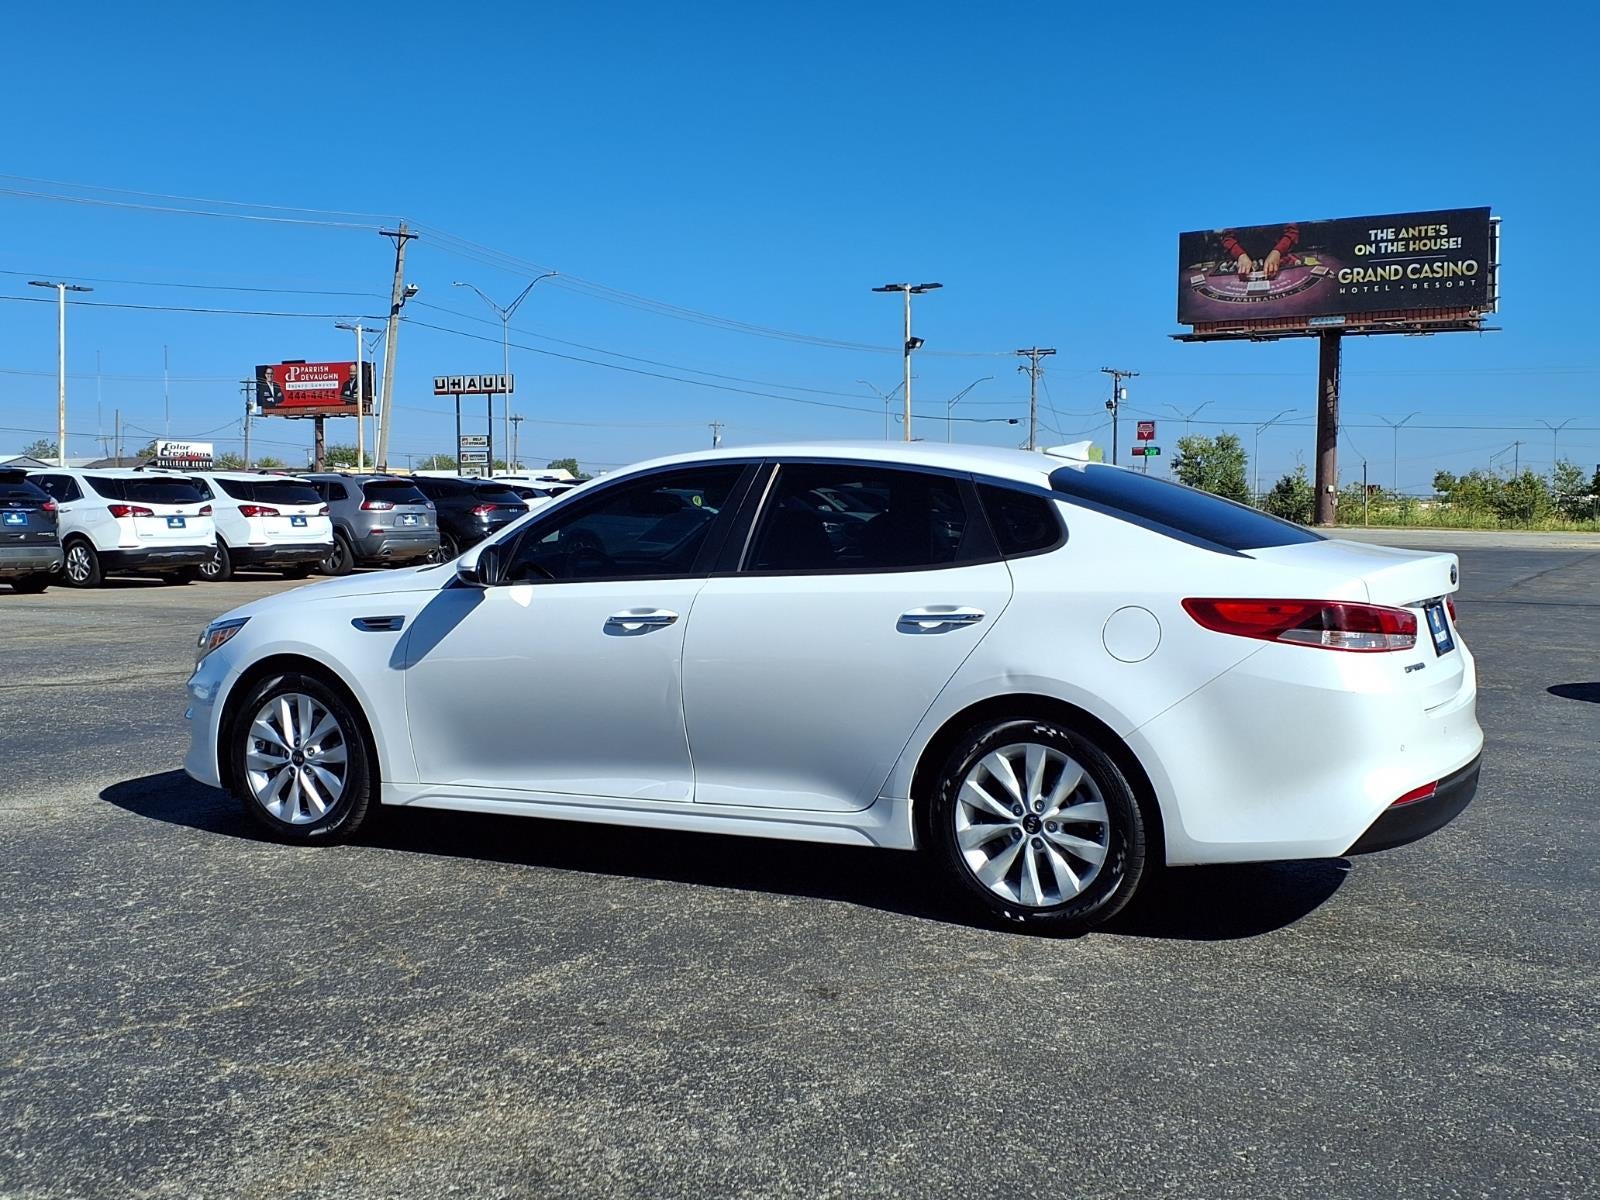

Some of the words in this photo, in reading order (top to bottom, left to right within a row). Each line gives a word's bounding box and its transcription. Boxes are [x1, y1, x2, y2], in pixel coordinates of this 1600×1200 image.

[1369, 228, 1396, 241] THE
[1399, 224, 1448, 239] ANTE'S
[1354, 243, 1376, 256] ON
[1379, 240, 1406, 254] THE
[1409, 236, 1462, 252] HOUSE!
[1338, 264, 1403, 284] GRAND
[1407, 259, 1478, 279] CASINO
[1339, 285, 1390, 294] HOTEL
[1412, 279, 1476, 290] RESORT
[300, 365, 329, 373] PARRISH
[300, 373, 339, 381] DEVAUGHN
[160, 447, 211, 457] Creations
[163, 442, 191, 451] Color
